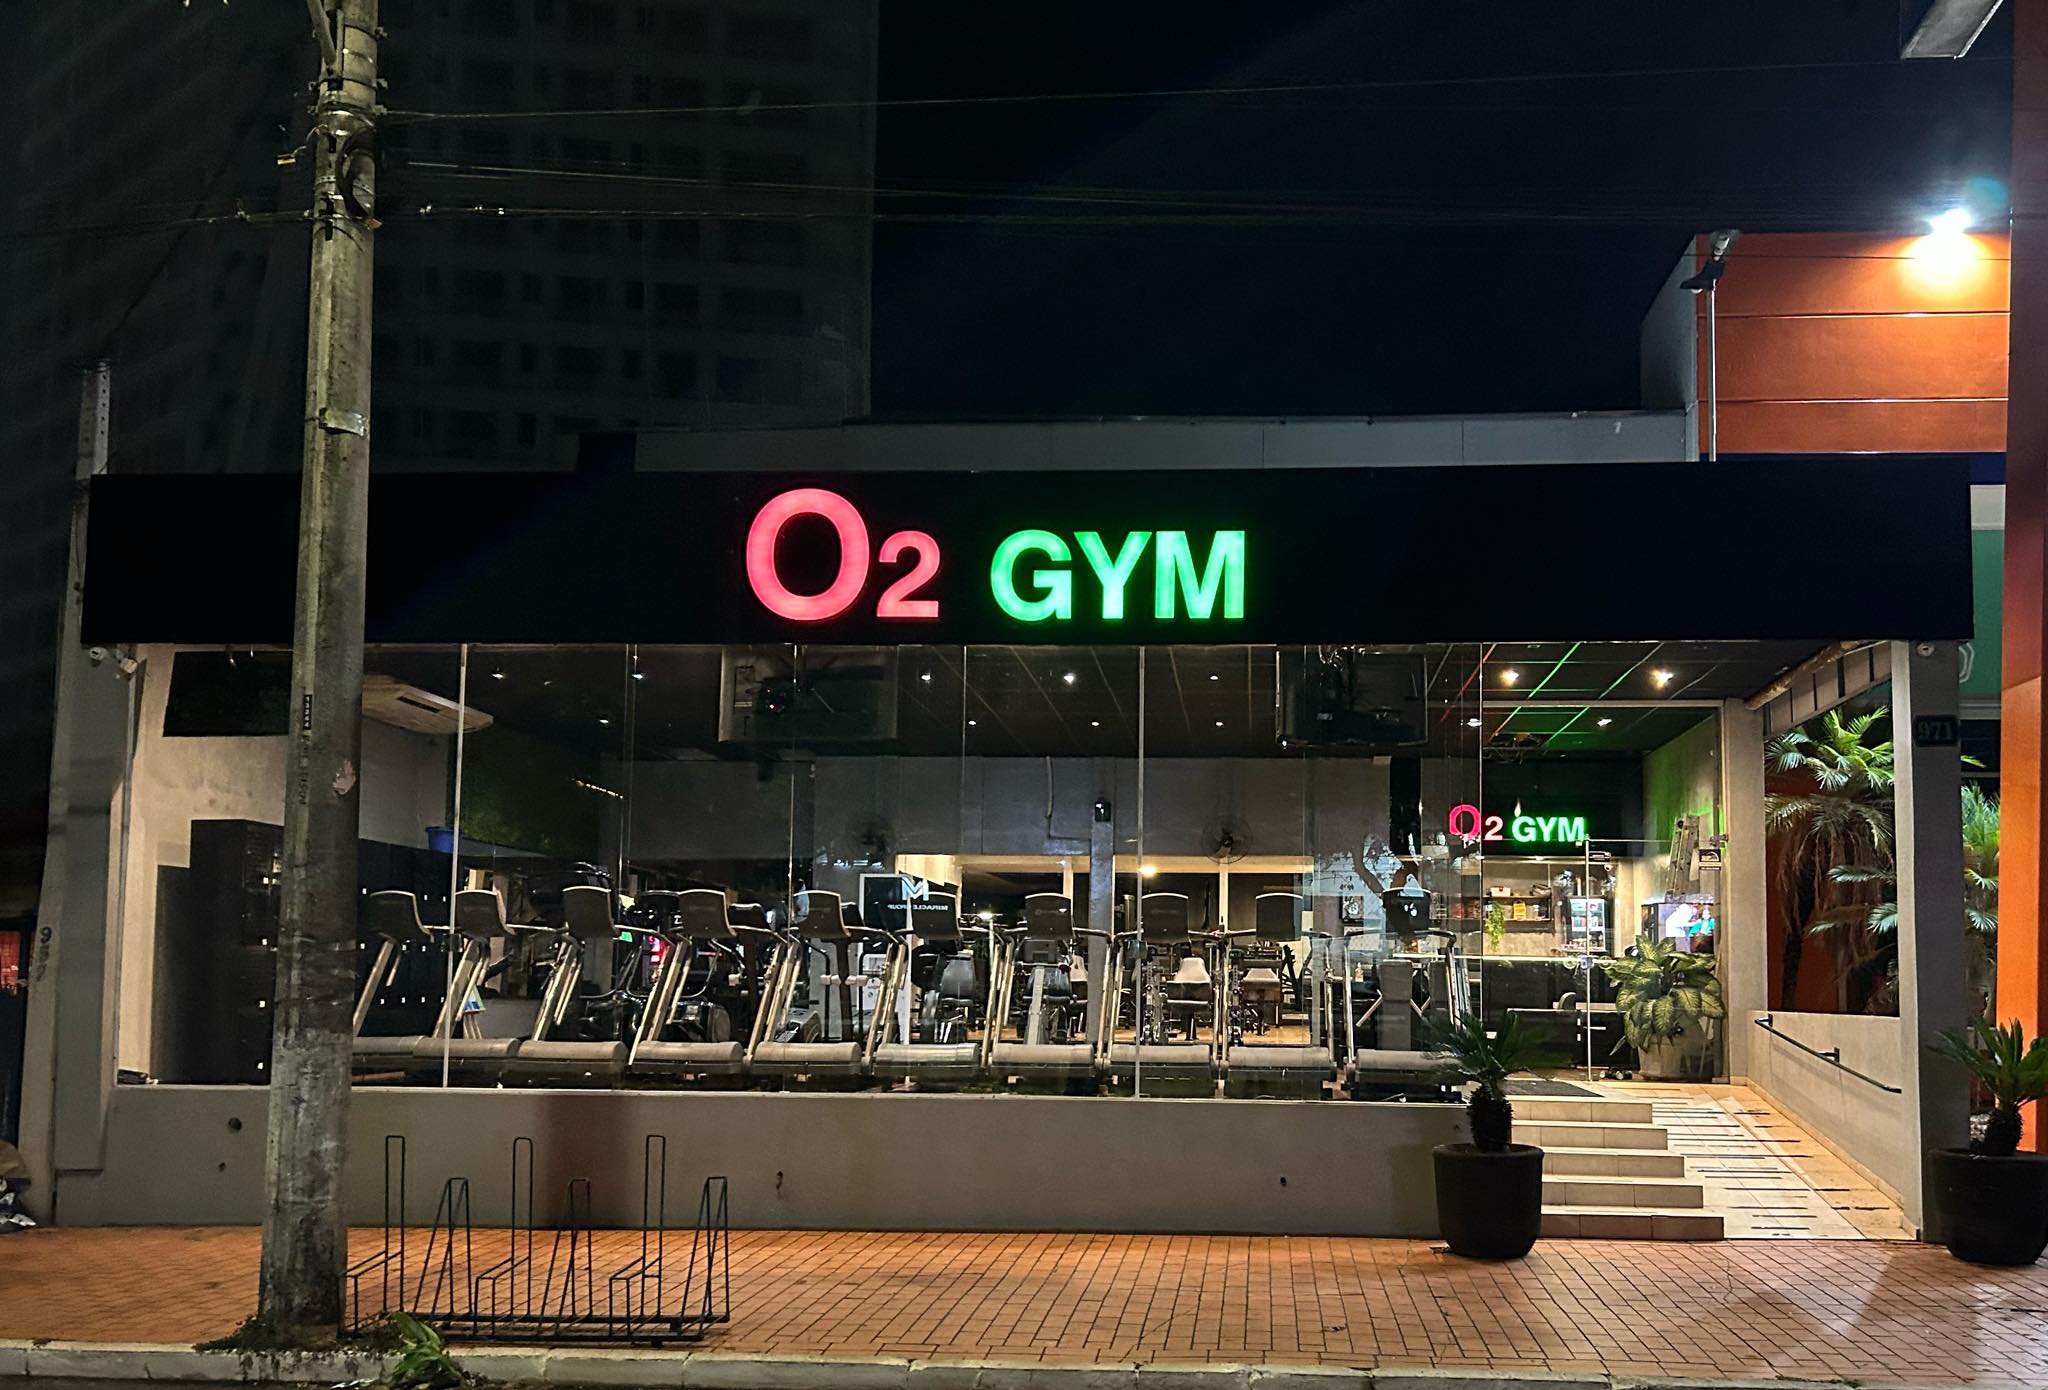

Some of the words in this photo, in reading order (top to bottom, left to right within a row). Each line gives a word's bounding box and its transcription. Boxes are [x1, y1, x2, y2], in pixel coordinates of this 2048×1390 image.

[746, 488, 941, 621] O2
[989, 529, 1246, 622] GYM
[1917, 721, 1954, 741] 971
[1511, 815, 1586, 843] GYM
